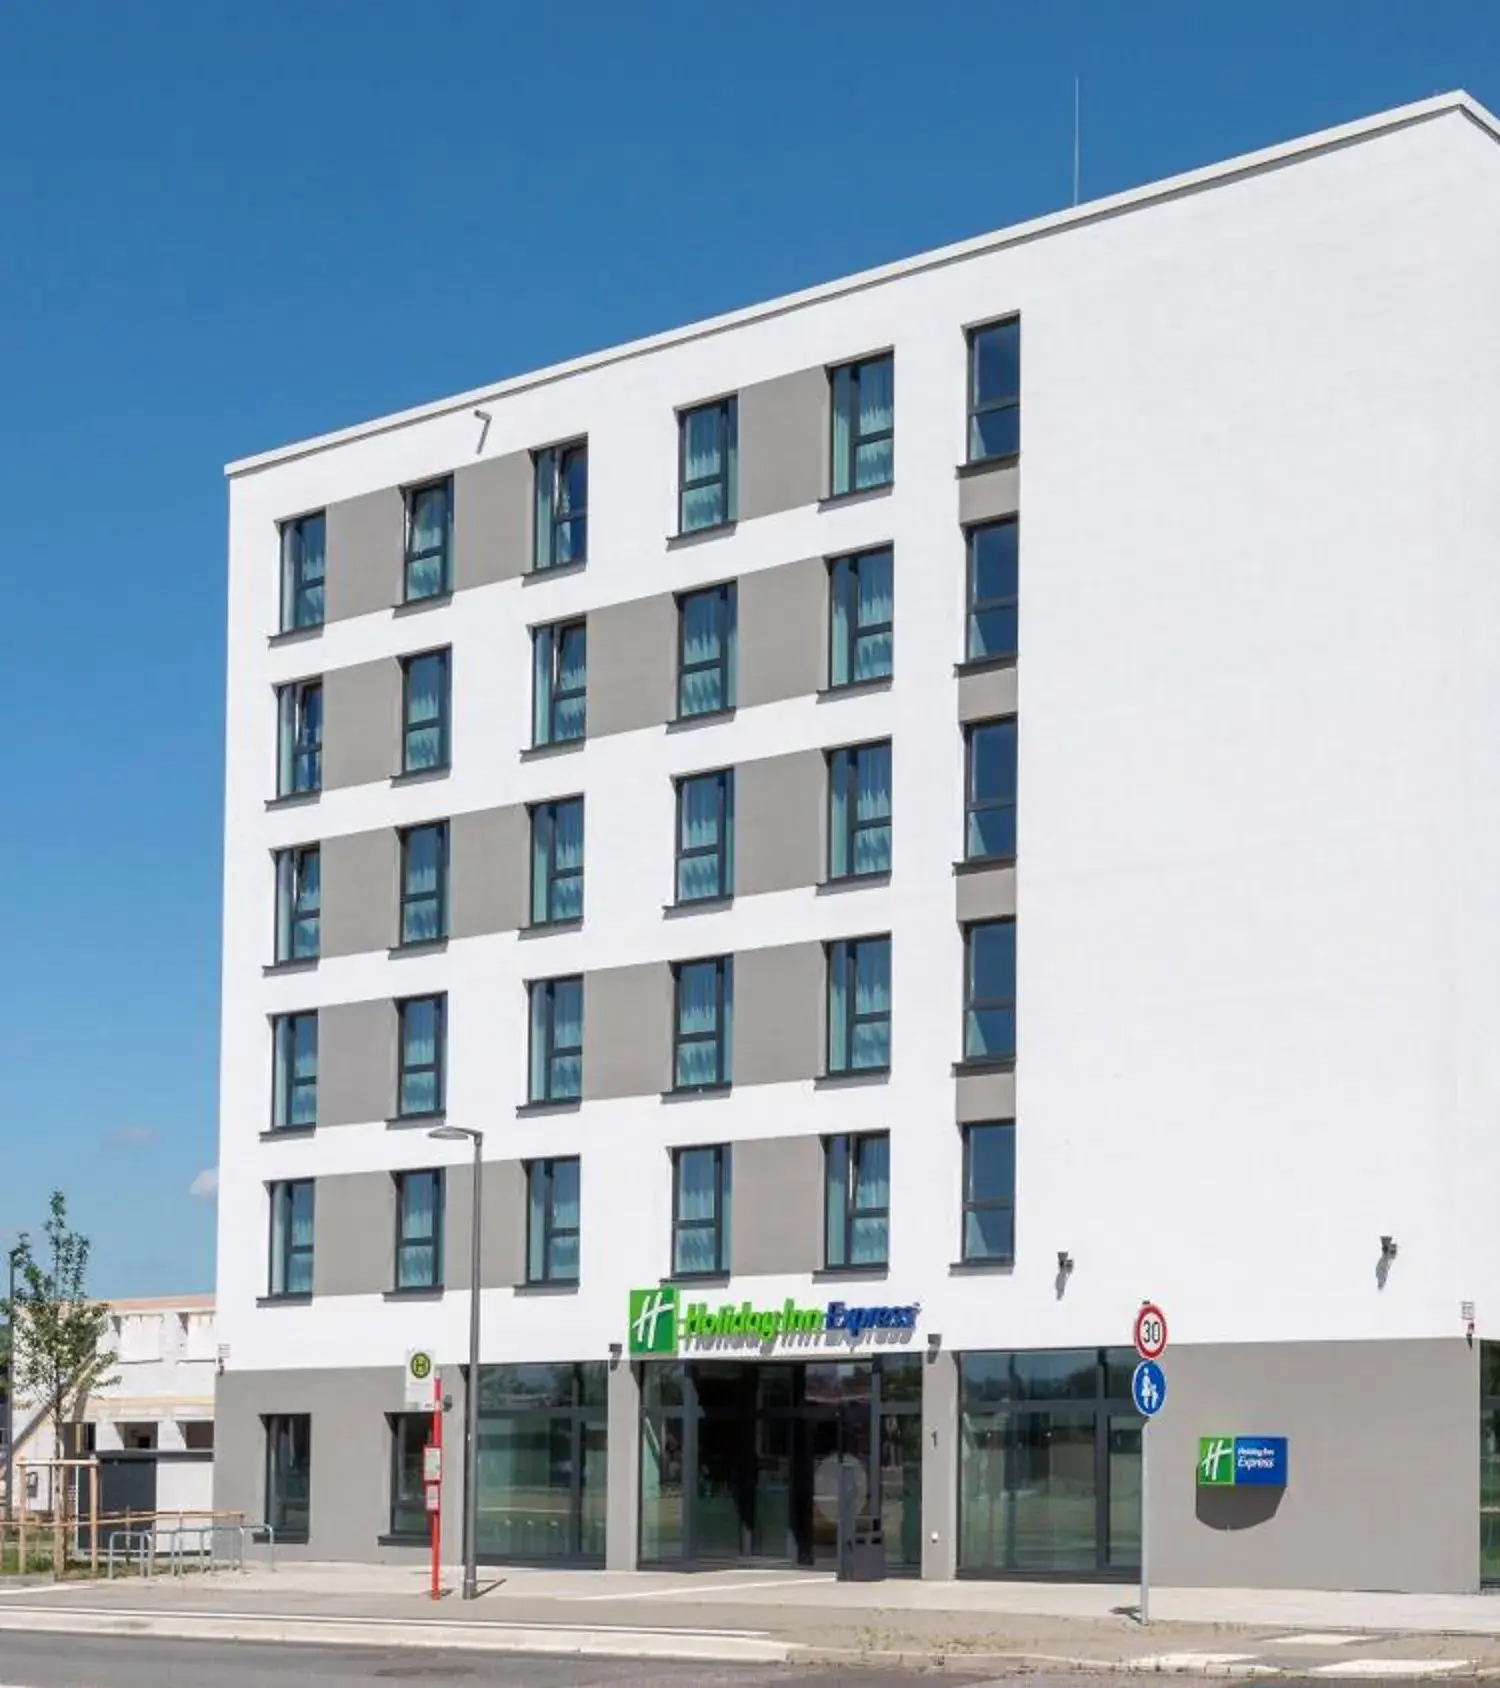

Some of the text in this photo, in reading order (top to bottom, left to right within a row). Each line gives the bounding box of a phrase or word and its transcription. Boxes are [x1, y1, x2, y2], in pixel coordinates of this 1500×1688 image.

[686, 1298, 917, 1338] Holiday Inn Express
[1143, 1320, 1161, 1343] 30
[415, 1359, 427, 1372] H
[931, 1431, 937, 1448] 1
[1237, 1456, 1275, 1470] Express
